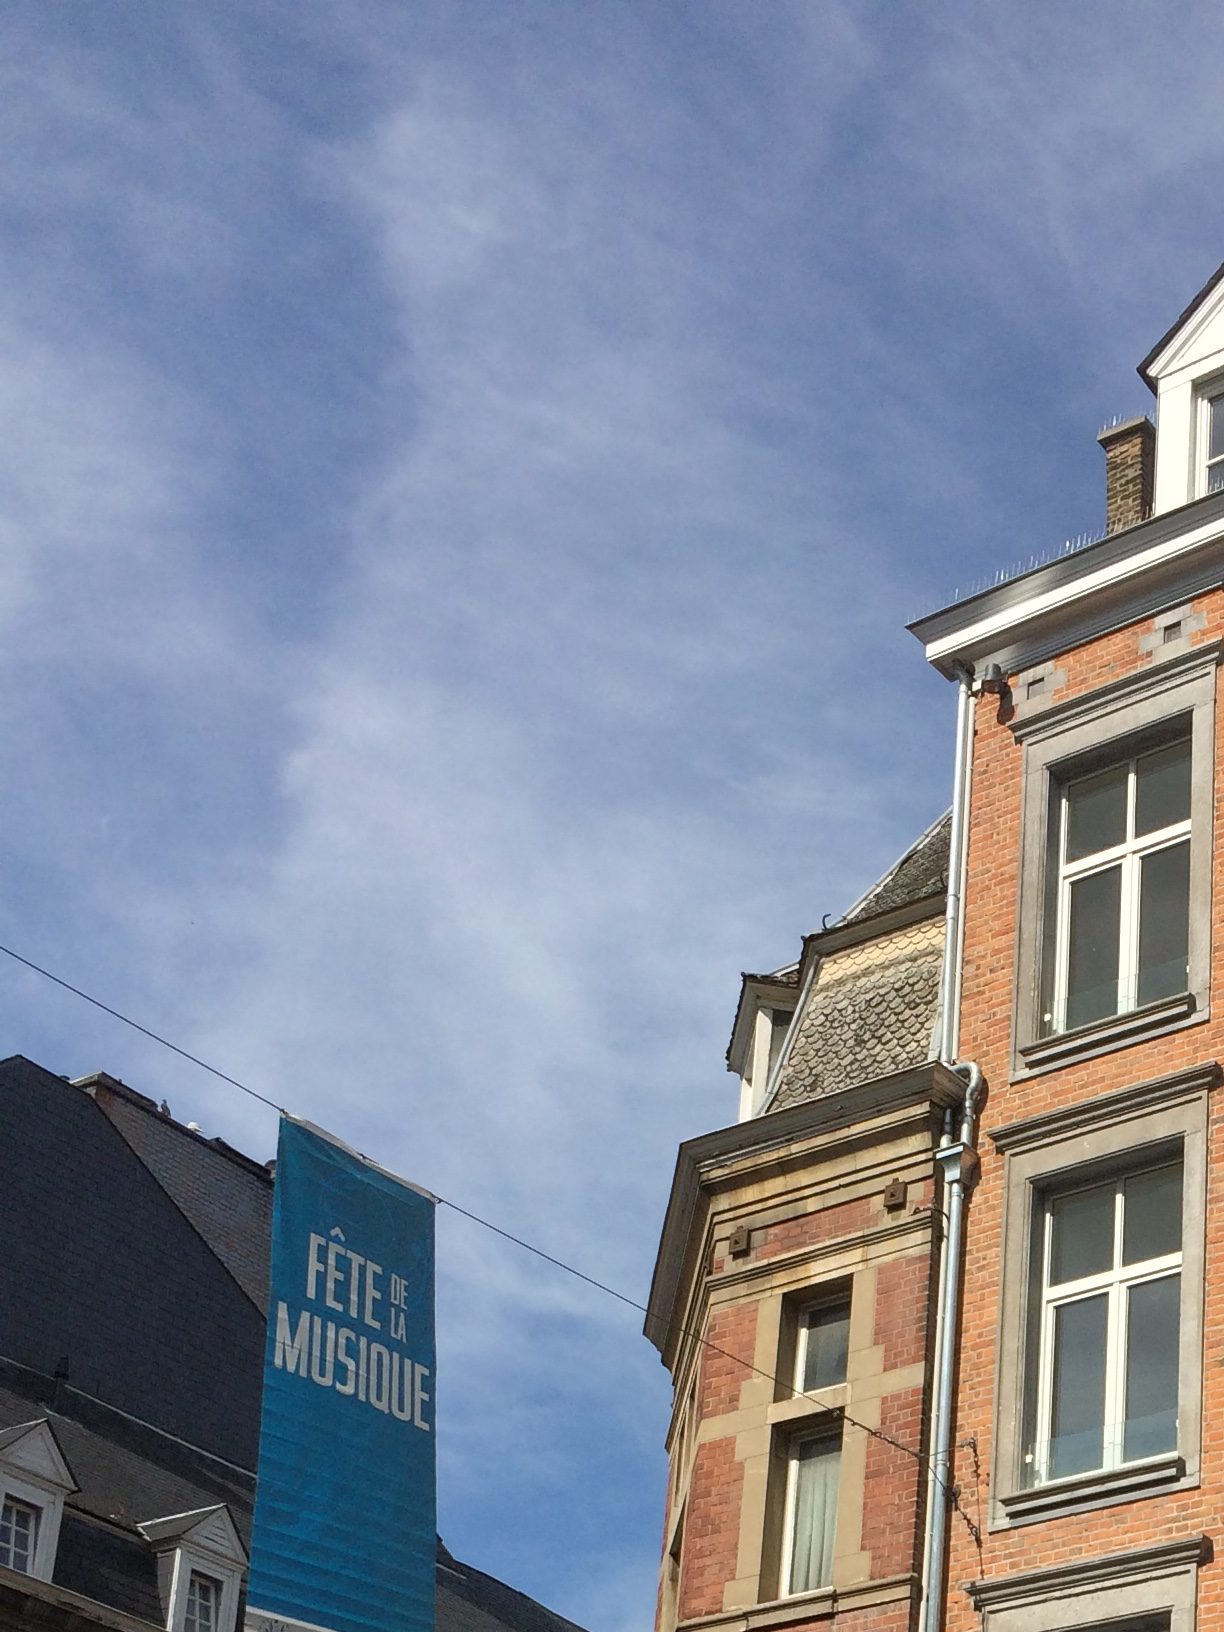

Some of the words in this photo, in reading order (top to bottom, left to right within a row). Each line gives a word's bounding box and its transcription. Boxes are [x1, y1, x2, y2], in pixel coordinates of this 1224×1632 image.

[307, 1227, 383, 1330] FÊTE
[390, 1273, 409, 1310] DE
[390, 1308, 408, 1344] LA
[274, 1301, 430, 1431] MUSIQUE
